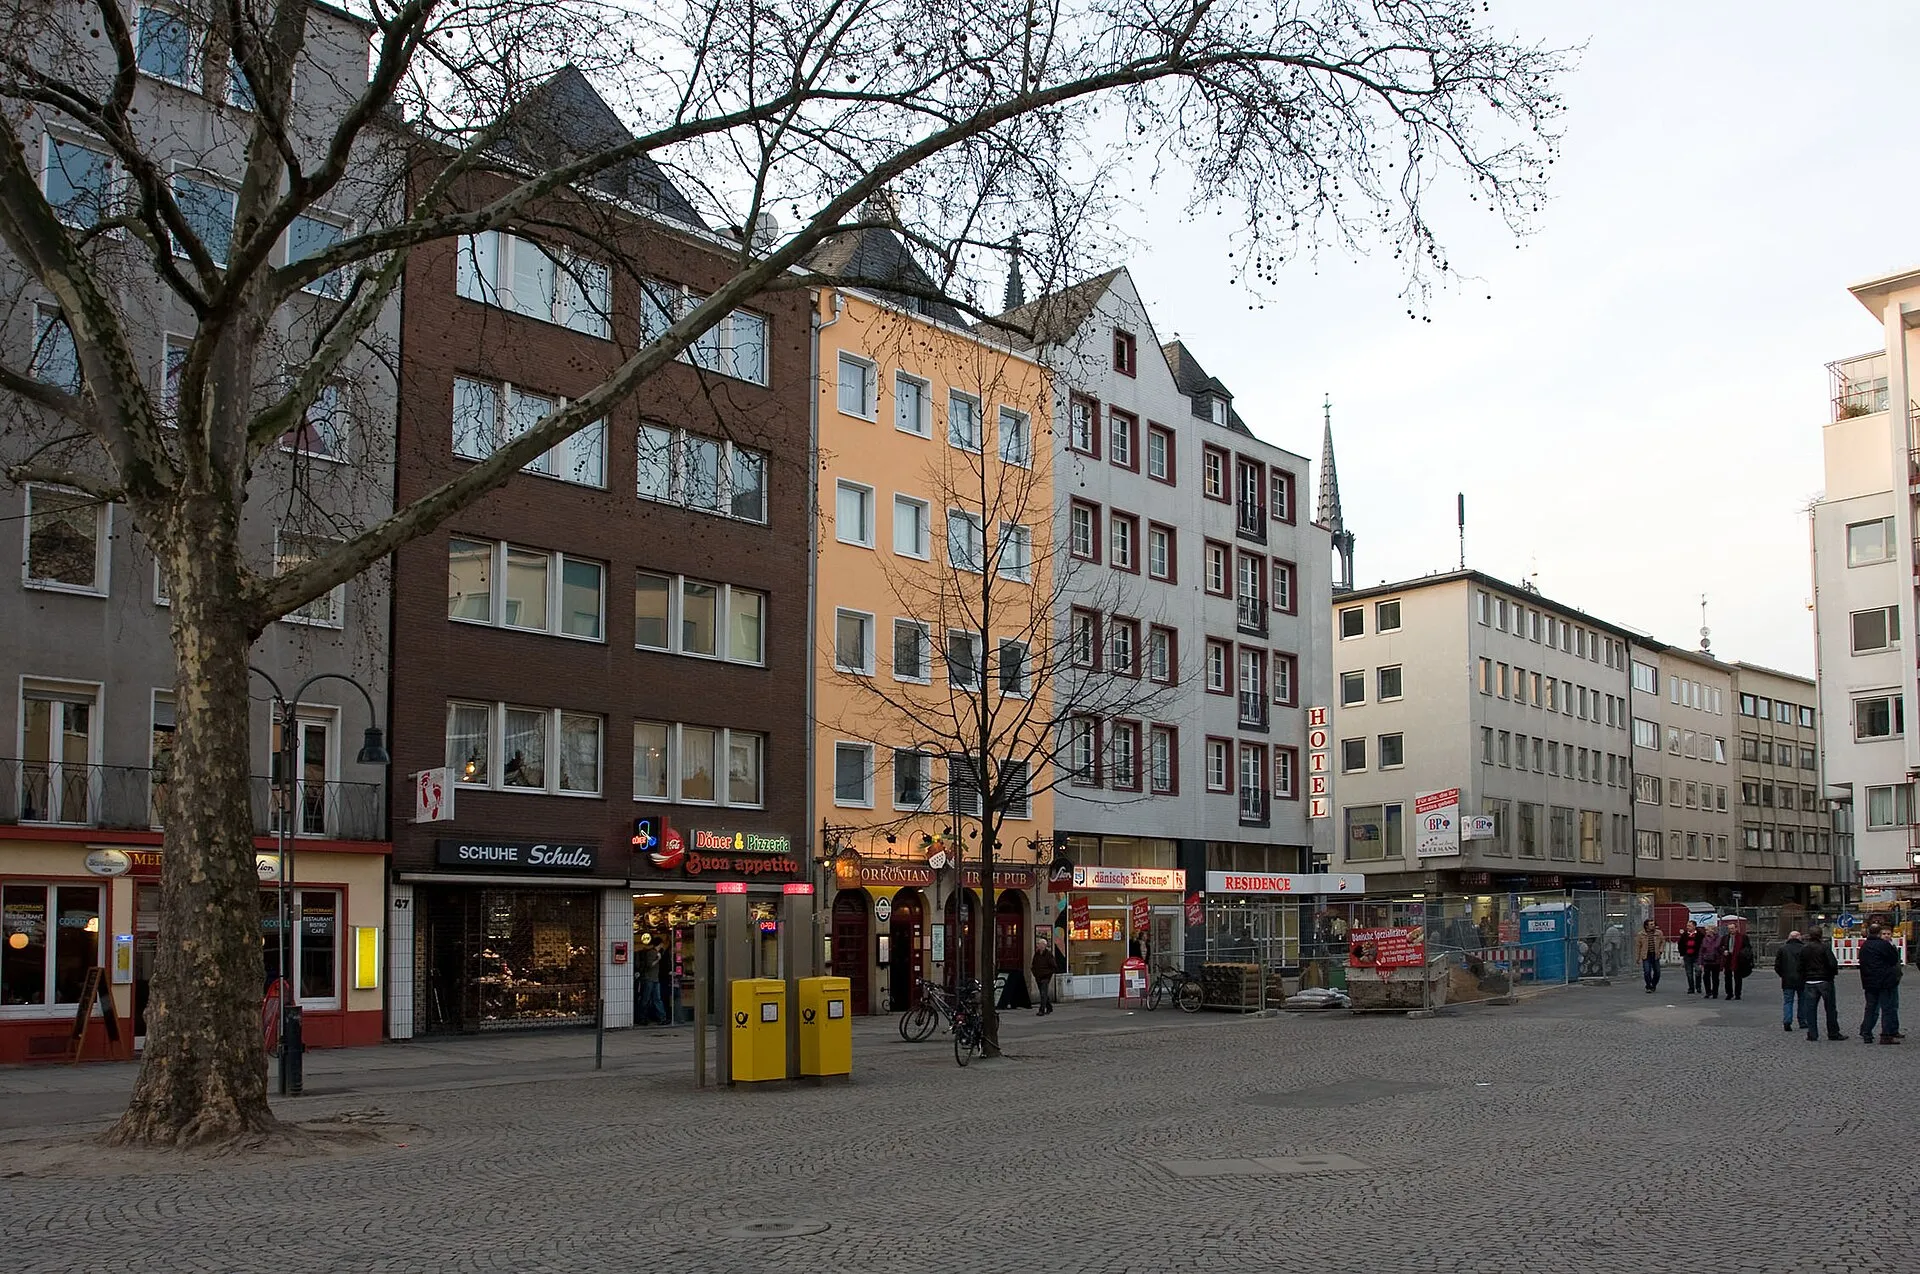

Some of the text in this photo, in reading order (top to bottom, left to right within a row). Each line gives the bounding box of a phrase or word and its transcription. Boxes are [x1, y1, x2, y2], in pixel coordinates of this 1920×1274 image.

[1310, 708, 1326, 817] HOTEL
[697, 831, 790, 852] Döner & Pizzeria
[459, 844, 592, 867] SCHUHE Schulz
[685, 851, 799, 875] Buon appetito
[884, 865, 900, 873] THE
[966, 871, 1027, 885] IRH PUB
[1225, 876, 1291, 891] RESIDENCE
[394, 899, 409, 909] 47
[760, 921, 776, 930] OPEN
[1374, 929, 1408, 940] Spezialitäten
